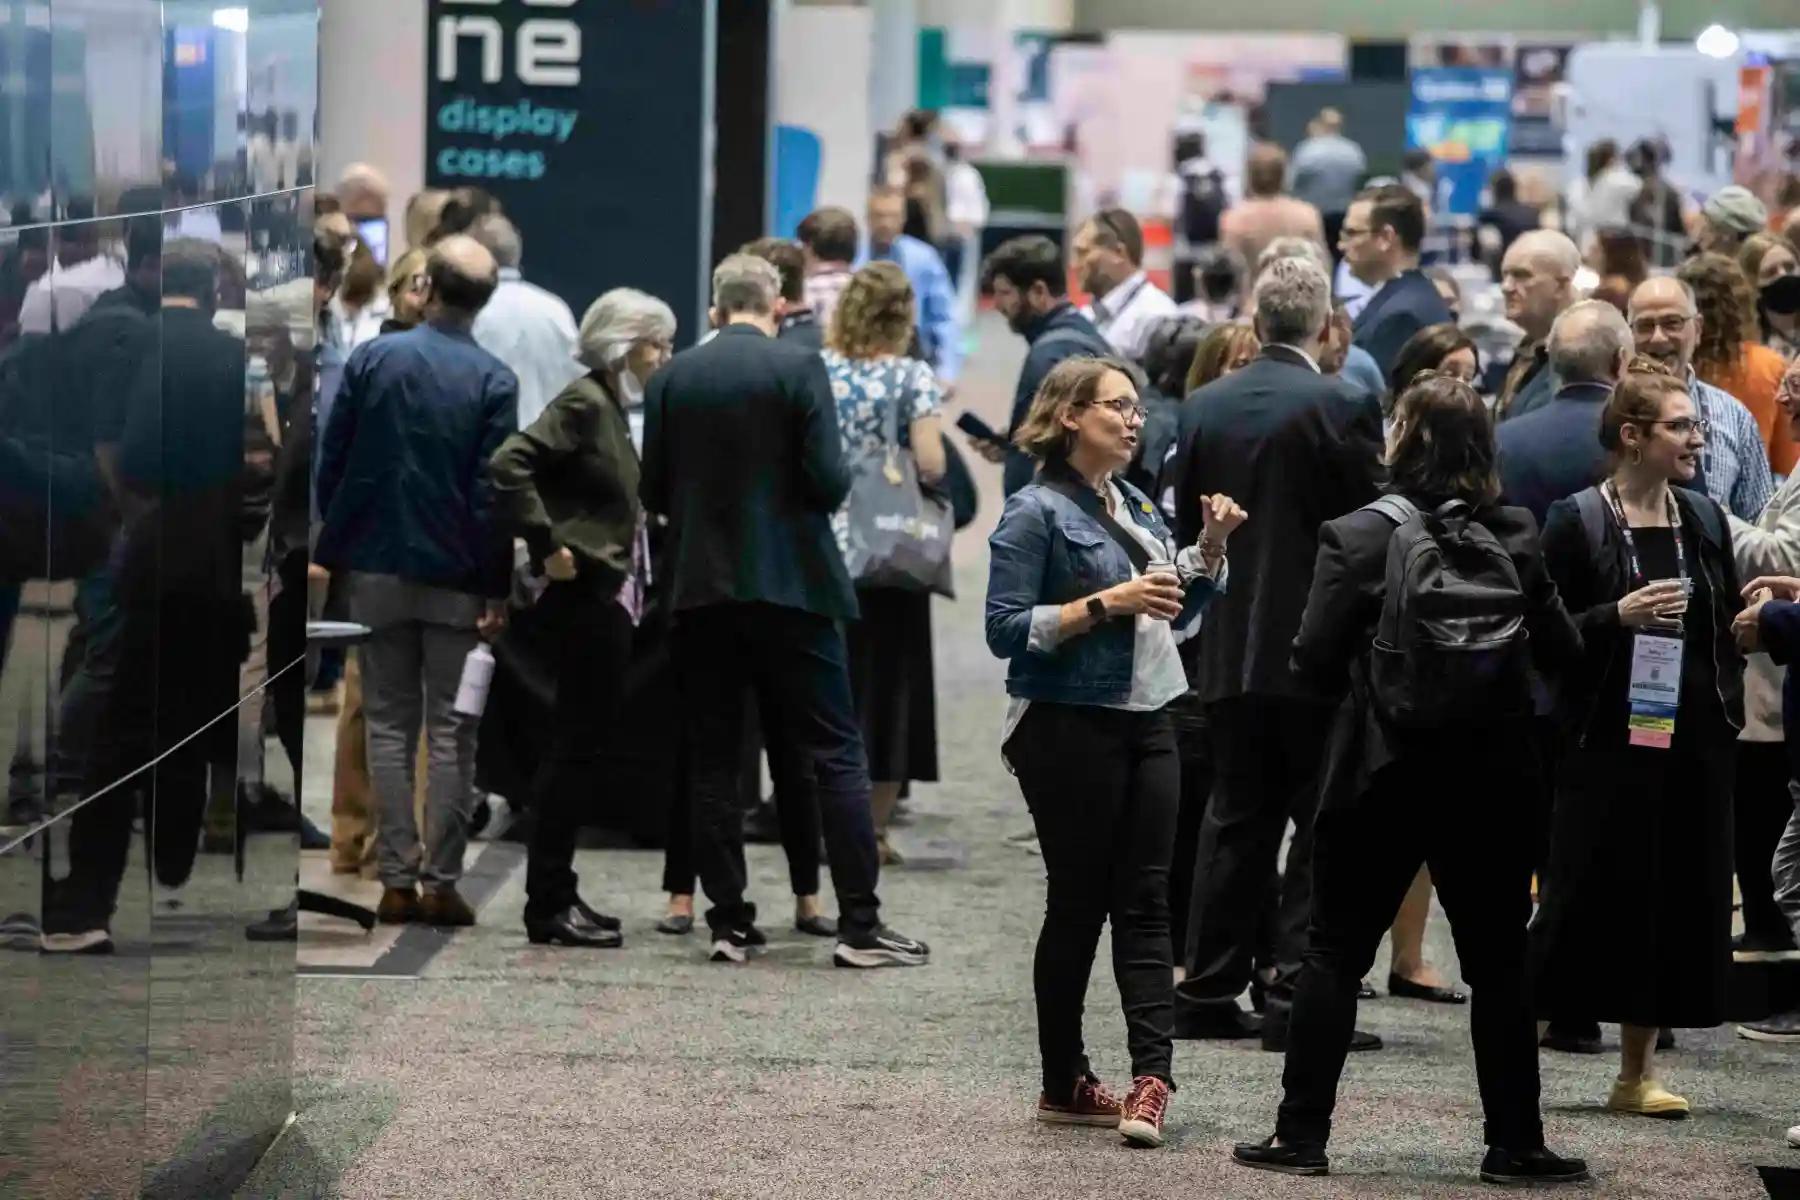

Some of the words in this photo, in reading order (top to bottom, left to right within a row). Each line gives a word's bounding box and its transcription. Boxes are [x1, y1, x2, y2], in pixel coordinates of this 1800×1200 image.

[437, 15, 581, 86] ne
[437, 98, 578, 143] display
[437, 147, 545, 180] cases
